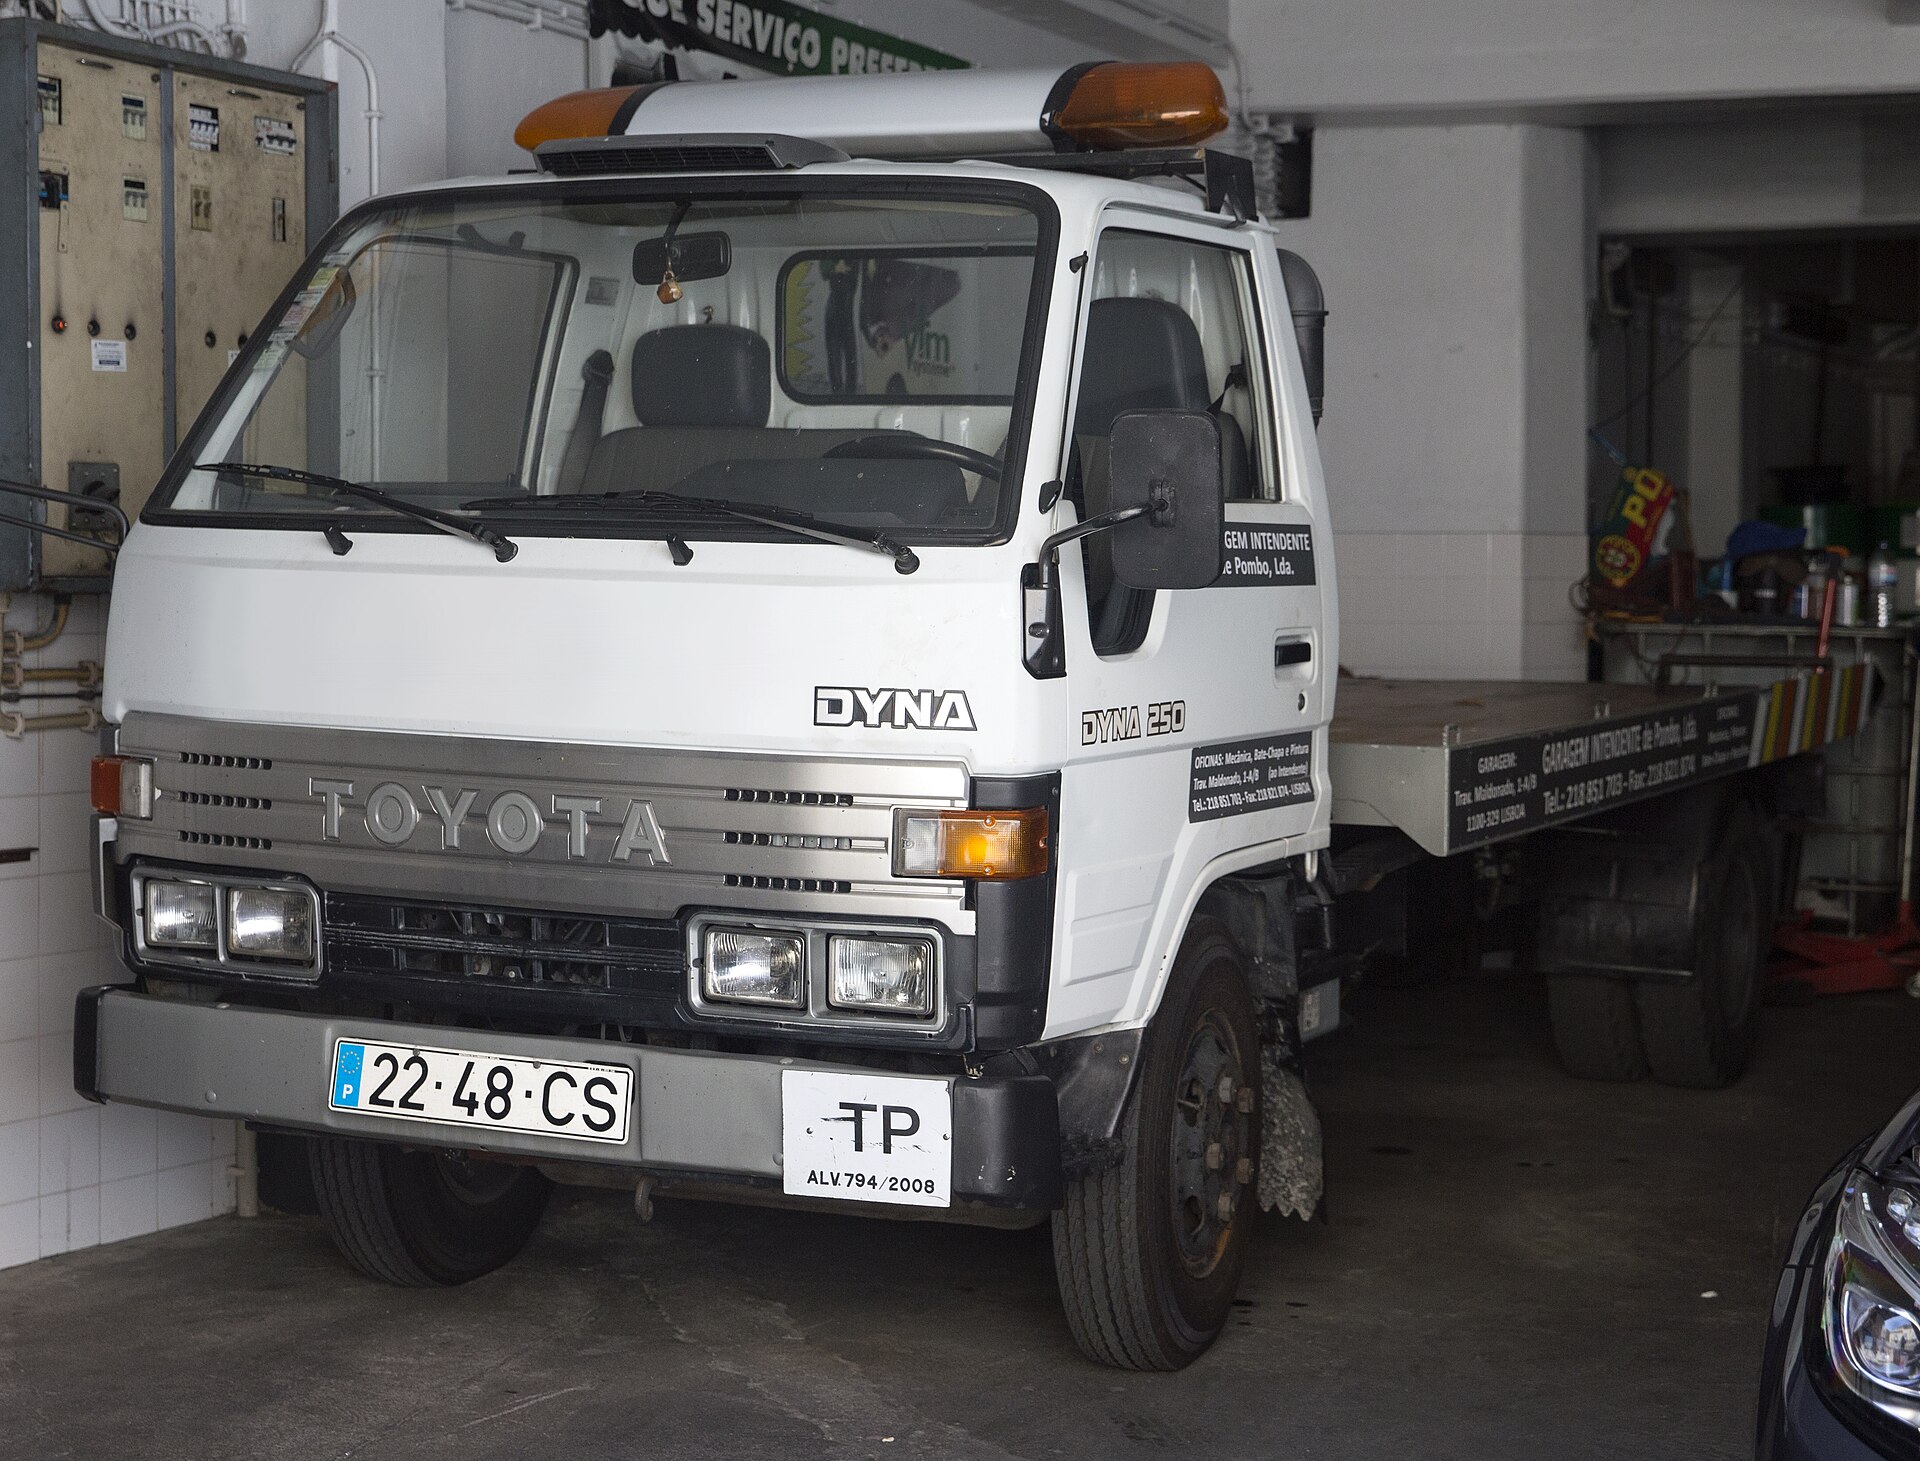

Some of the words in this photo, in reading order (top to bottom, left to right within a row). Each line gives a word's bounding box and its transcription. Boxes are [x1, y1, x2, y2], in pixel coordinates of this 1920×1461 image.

[697, 0, 821, 72] SERVIÇO
[1250, 531, 1311, 551] INTENDENTE
[1234, 556, 1273, 579] Pombo,
[1273, 556, 1295, 576] Lda.
[813, 686, 977, 731] DYNA
[1081, 706, 1142, 746] DYNA
[1147, 700, 1186, 737] 250
[1194, 753, 1224, 769] OFICINAS:
[1477, 751, 1518, 774] GARAGEM:
[1542, 736, 1590, 775] GARAGEM
[1591, 724, 1642, 763] INTENDENTE
[309, 777, 673, 866] TOYOTA
[342, 1083, 353, 1099] P
[839, 1101, 920, 1155] TP
